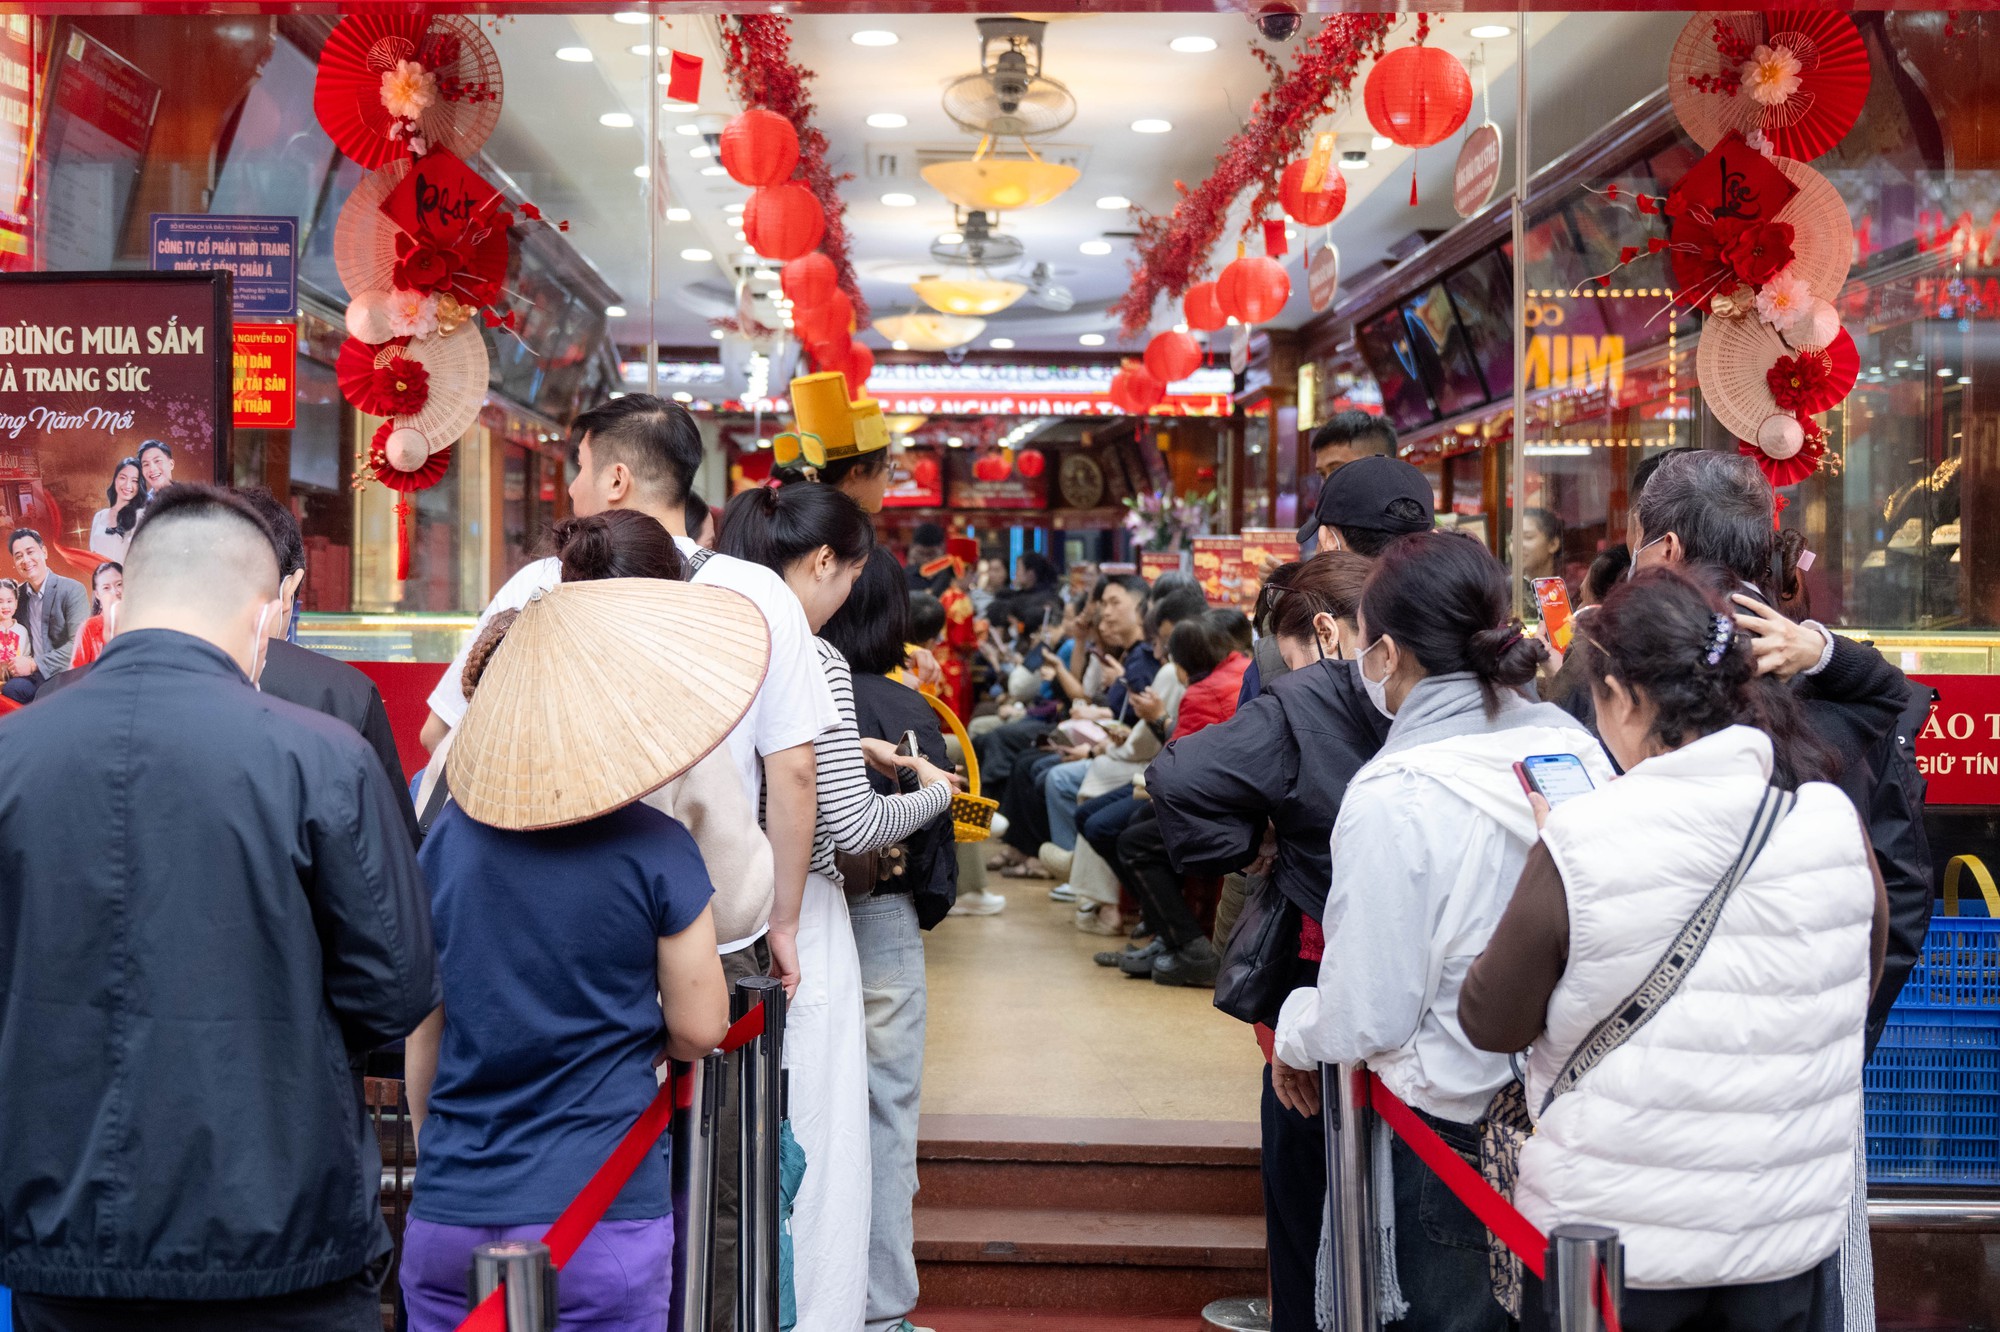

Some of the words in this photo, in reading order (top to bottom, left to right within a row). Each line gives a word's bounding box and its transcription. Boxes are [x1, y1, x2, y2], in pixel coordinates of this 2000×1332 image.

[415, 172, 476, 230] Phát
[158, 237, 183, 254] CÔNG
[185, 241, 195, 254] TY
[197, 236, 210, 255] CỔ
[212, 237, 237, 256] PHẦN
[239, 239, 259, 256] THỜI
[261, 243, 290, 257] TRANG
[239, 261, 264, 277] CHÂU
[265, 262, 273, 277] Á
[0, 320, 74, 355] BỪNG
[81, 326, 141, 355] MUA
[147, 315, 205, 355] SẮM
[238, 331, 272, 343] NGUYỄN
[274, 335, 286, 343] DU
[250, 352, 271, 369] DÂN
[22, 367, 100, 392] TRANG
[106, 362, 151, 392] SỨC
[246, 374, 262, 391] TÀI
[264, 373, 286, 391] SẢN
[244, 397, 271, 416] THẬN
[28, 406, 85, 434] Năm
[83, 406, 135, 435] Mới
[1915, 752, 1956, 775] GIỮ
[1961, 752, 1998, 775] TÍN
[1573, 1017, 1630, 1077] CHRISTIAN
